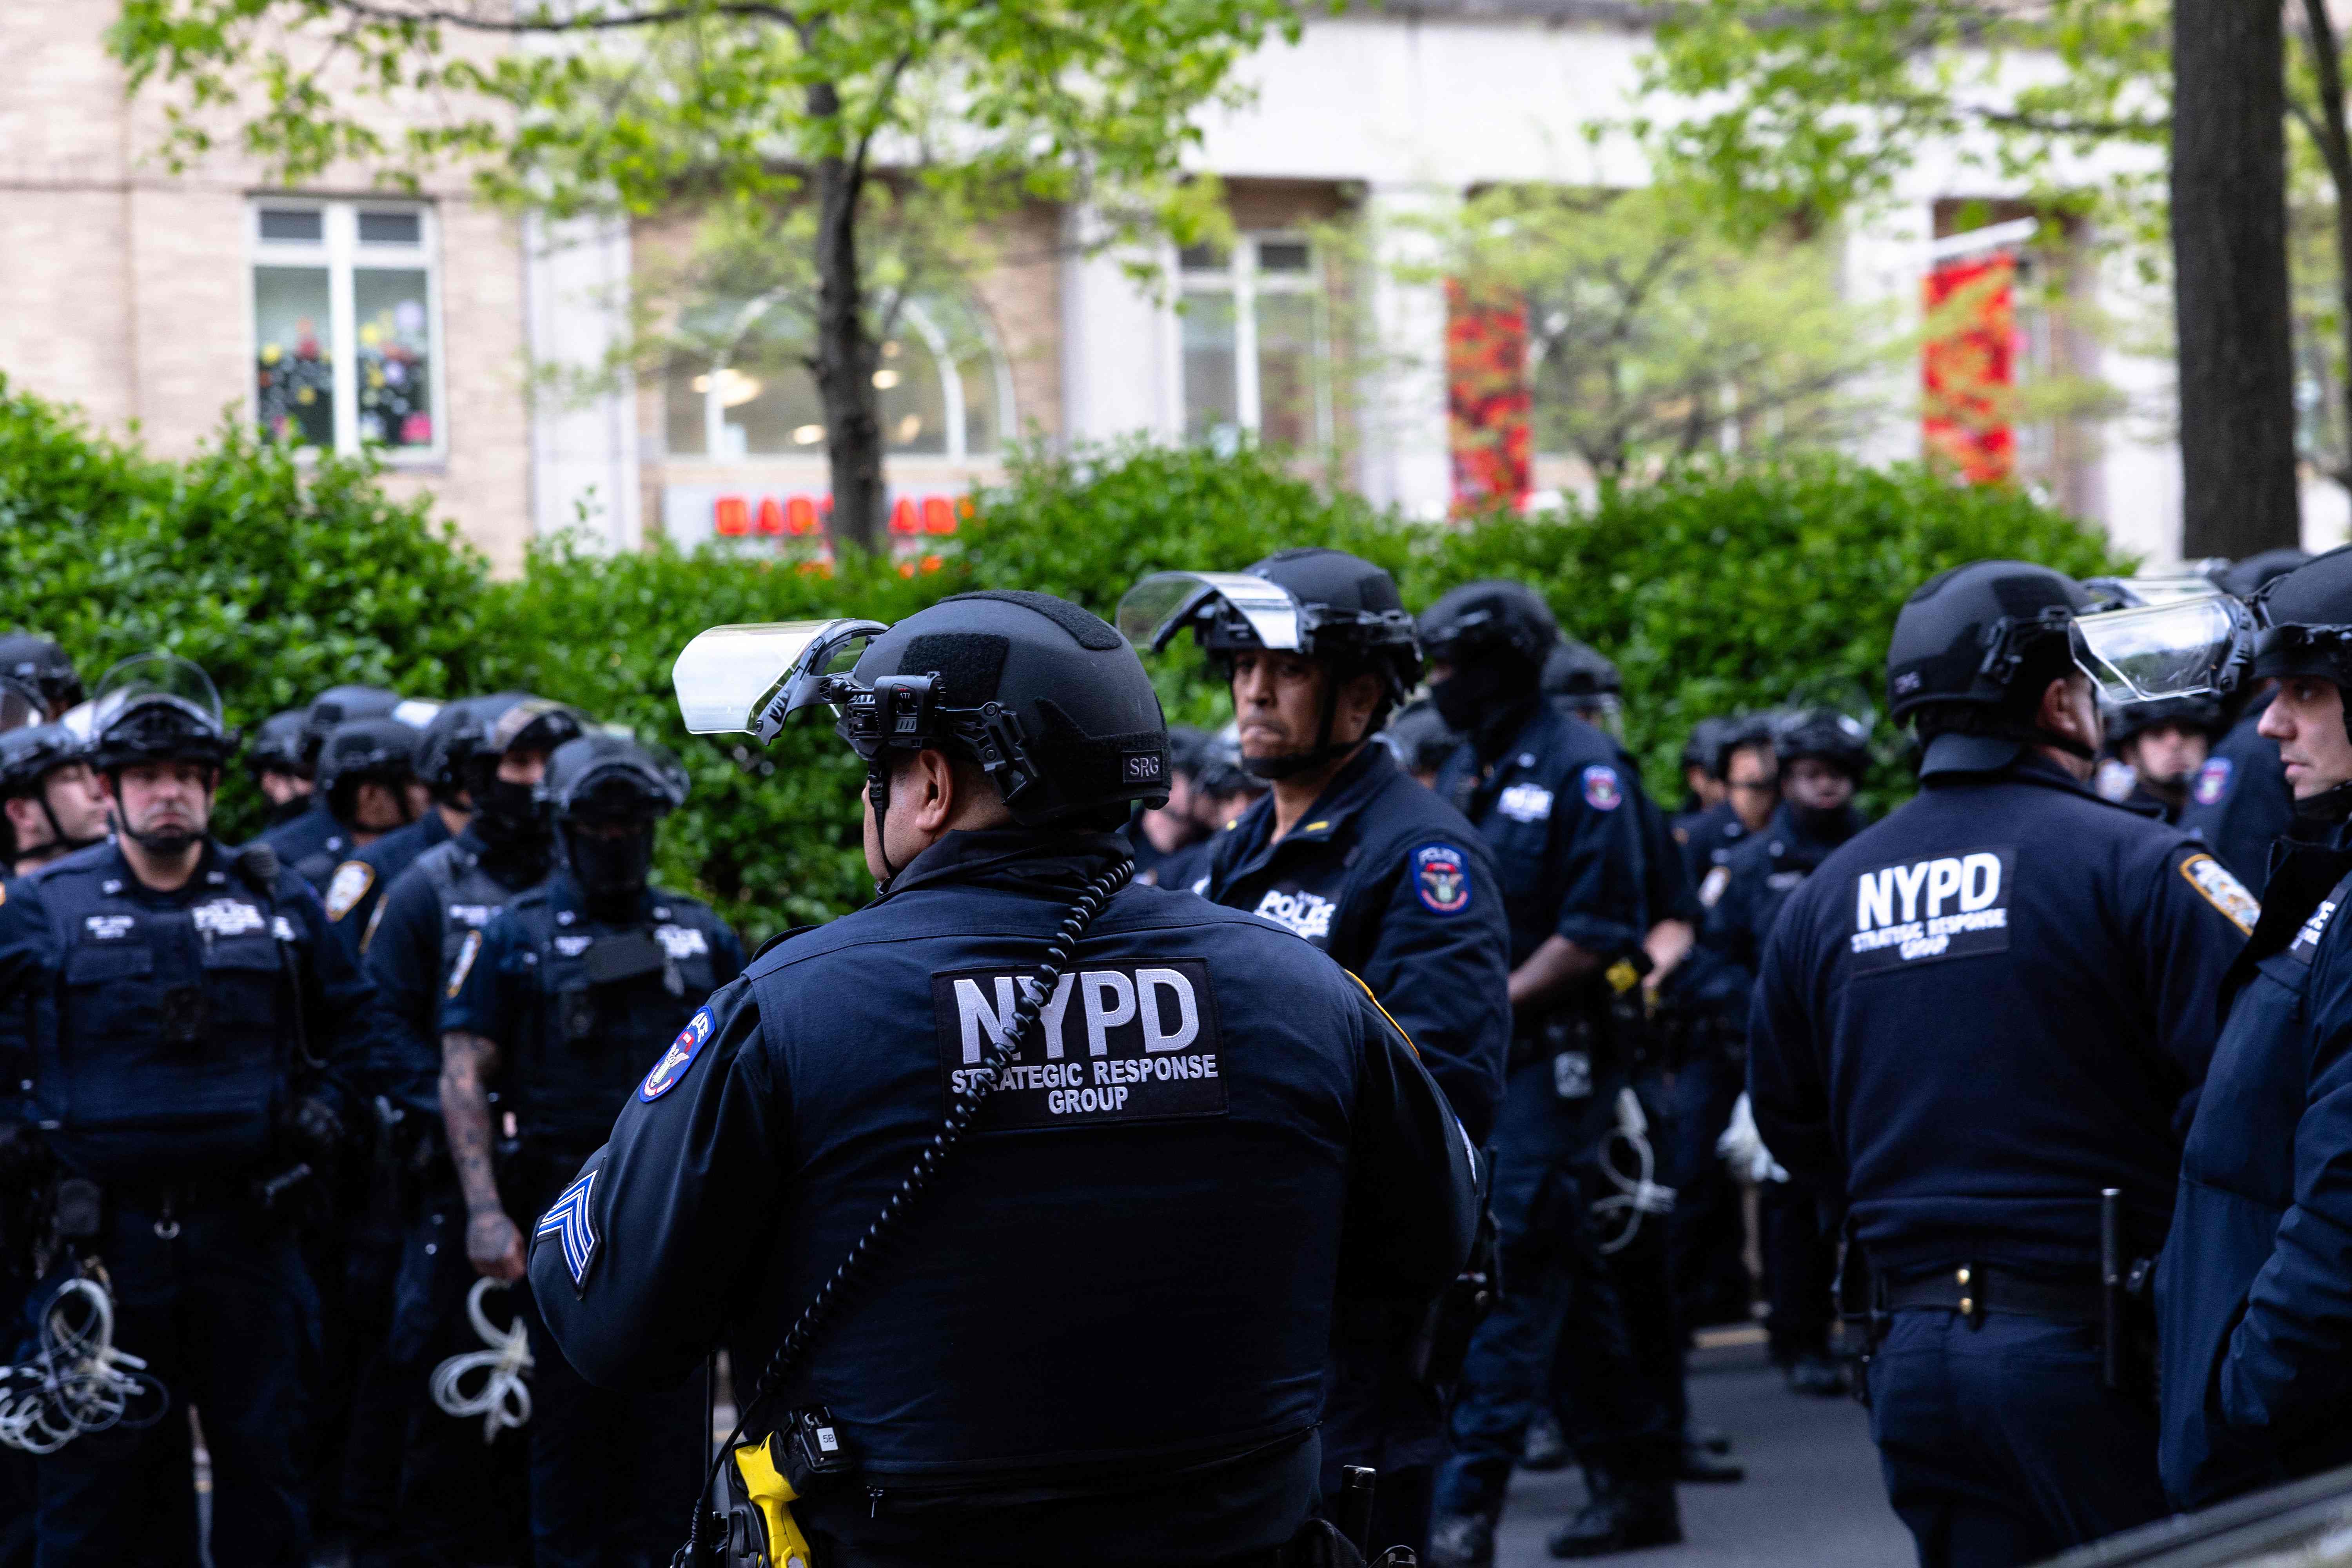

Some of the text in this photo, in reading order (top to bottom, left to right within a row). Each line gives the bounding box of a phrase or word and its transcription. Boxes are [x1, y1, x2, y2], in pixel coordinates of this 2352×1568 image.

[1129, 757, 1159, 777] SRG
[1857, 852, 2001, 932] NYPD
[953, 968, 1200, 1065] NYPD
[1094, 1054, 1218, 1086] RESPONSE
[1048, 1086, 1129, 1114] GROUP
[822, 1434, 835, 1443] 5B
